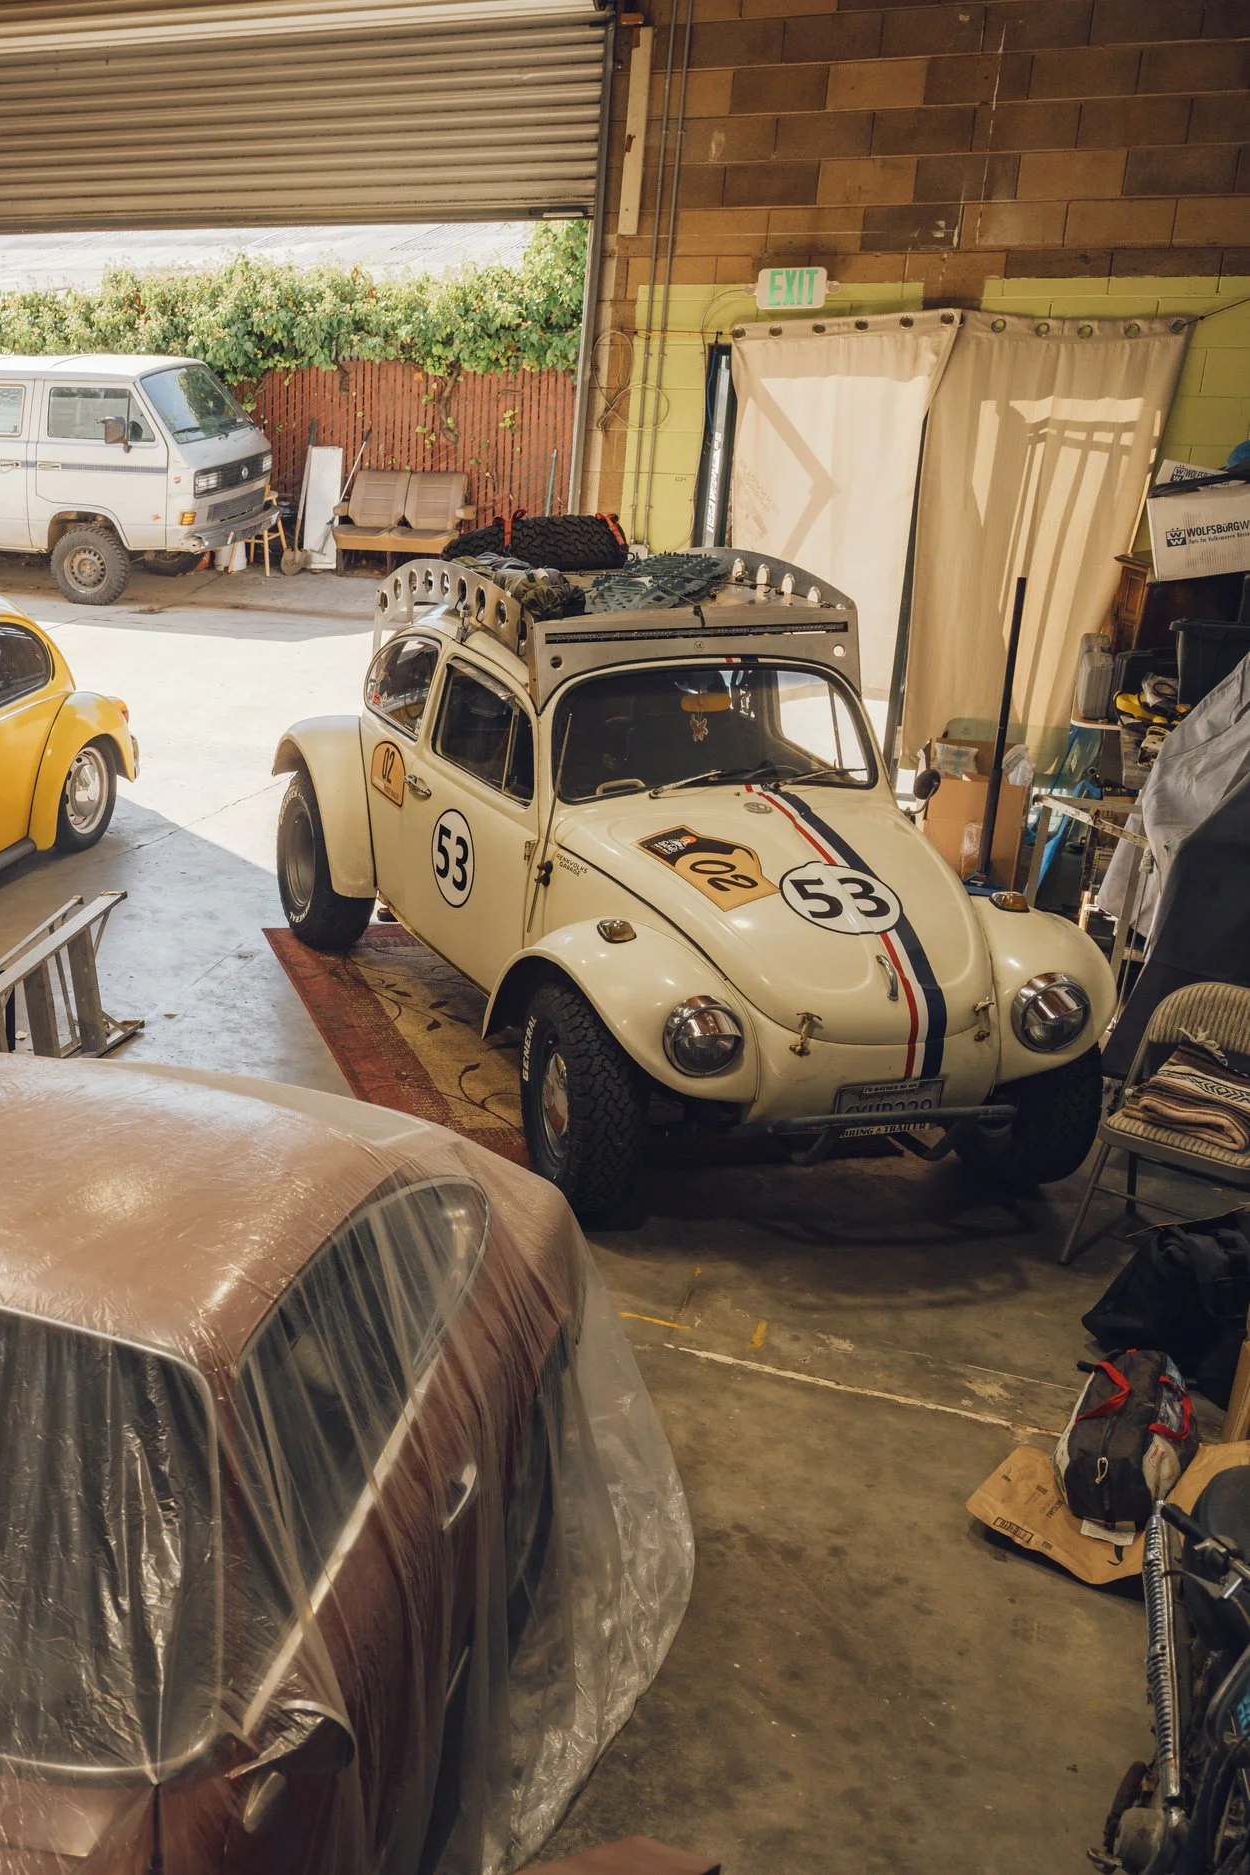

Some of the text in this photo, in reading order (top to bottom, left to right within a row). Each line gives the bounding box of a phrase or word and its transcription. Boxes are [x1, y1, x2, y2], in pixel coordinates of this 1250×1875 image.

[768, 269, 819, 306] EXIT
[381, 747, 396, 785] 02
[435, 823, 469, 892] 53
[556, 853, 589, 874] RENNVOLKS
[558, 861, 581, 877] GARAGE
[788, 877, 891, 919] 53
[522, 1016, 538, 1082] GENERAL
[842, 1128, 873, 1137] BRING
[884, 1122, 926, 1133] TRAILER
